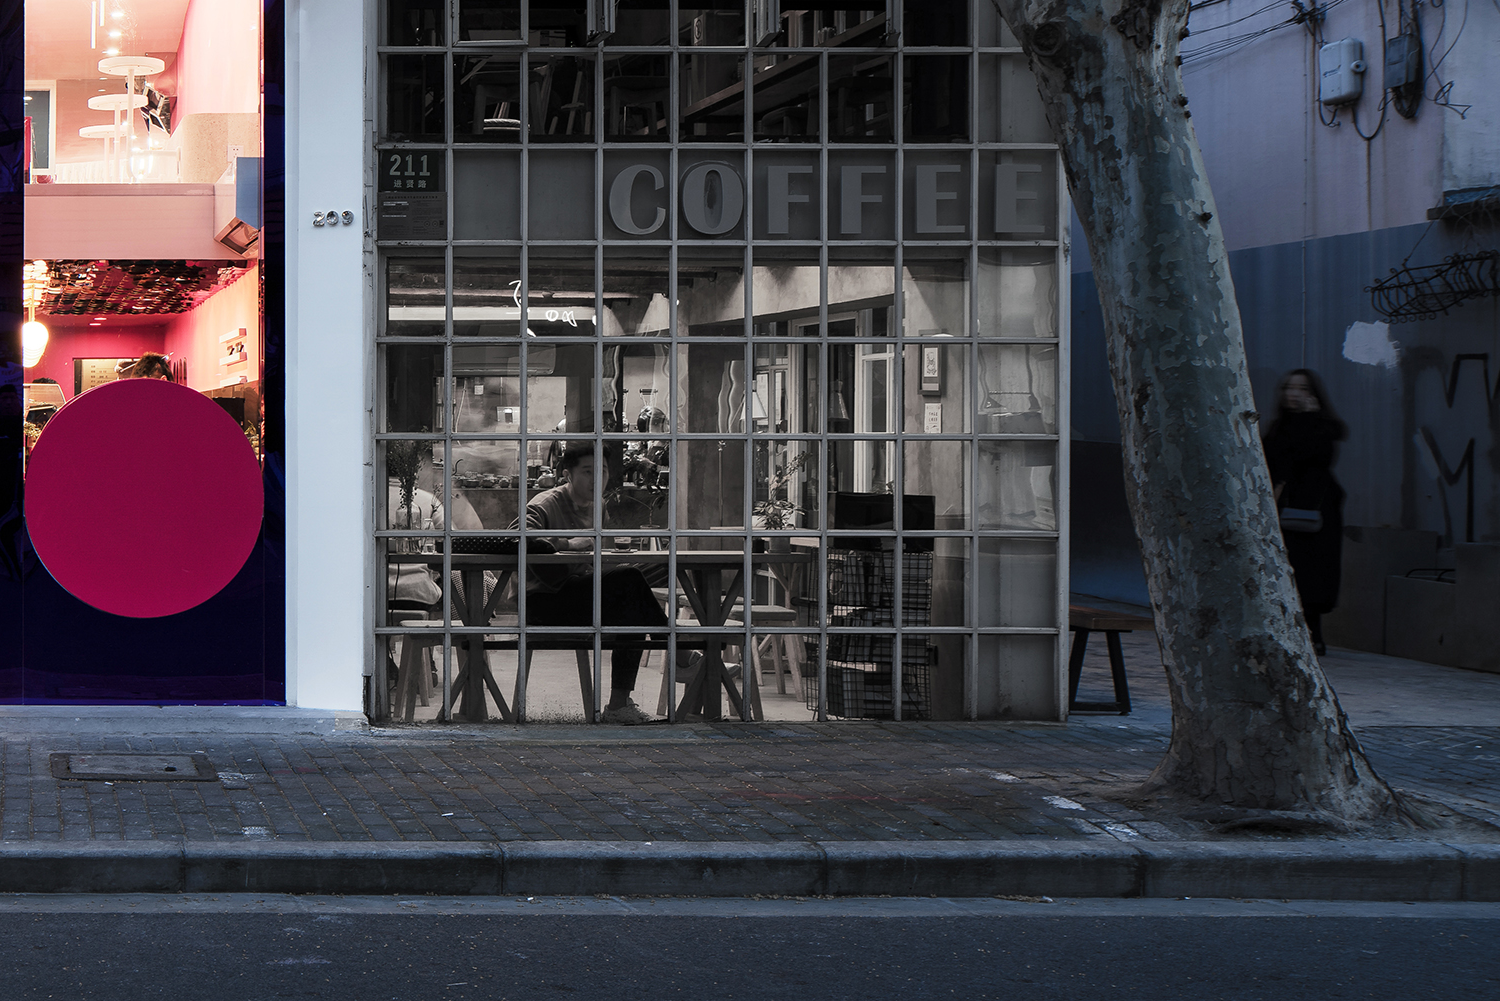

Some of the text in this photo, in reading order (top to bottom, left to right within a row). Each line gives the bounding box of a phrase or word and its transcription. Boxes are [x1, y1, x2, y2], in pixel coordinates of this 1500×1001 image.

[389, 153, 431, 177] 211
[393, 179, 427, 189] 进贤路
[608, 163, 1046, 235] COFFEE
[312, 210, 355, 227] 209
